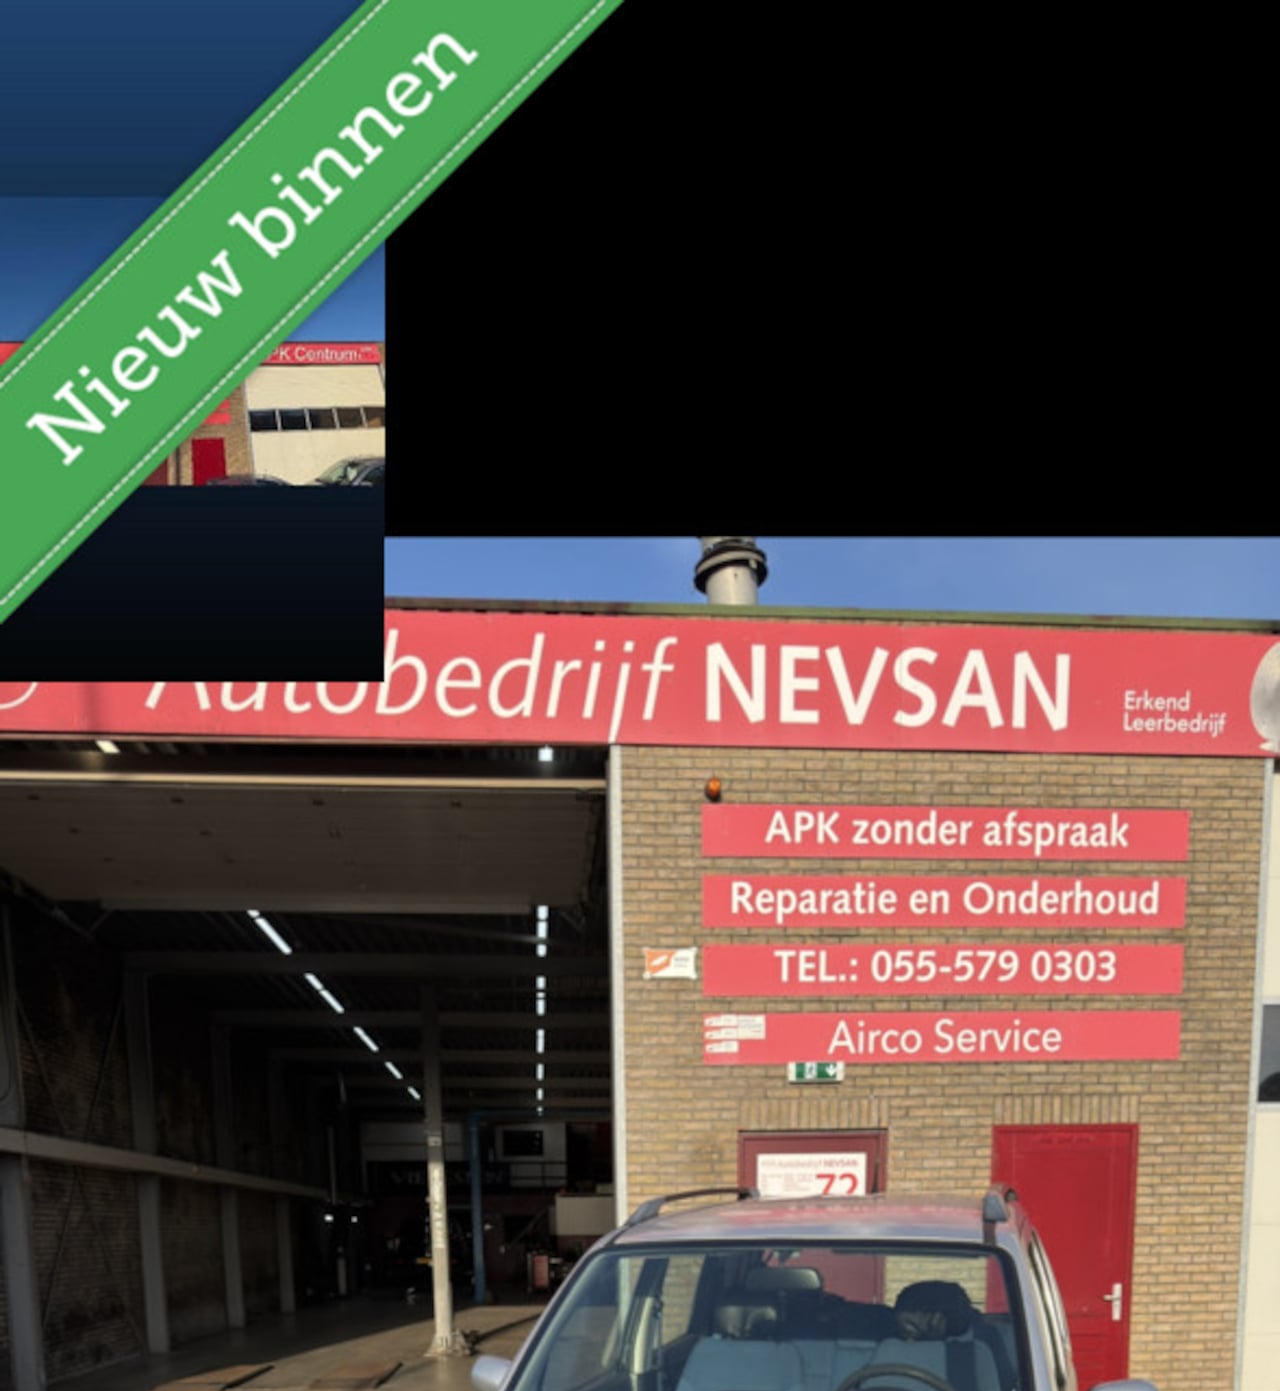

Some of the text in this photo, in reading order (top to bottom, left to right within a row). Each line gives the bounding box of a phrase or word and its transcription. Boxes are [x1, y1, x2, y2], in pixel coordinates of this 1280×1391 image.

[707, 643, 1070, 731] NEVSAN
[1124, 690, 1190, 711] Erkend
[1123, 712, 1226, 736] Leerbedrijf
[765, 810, 1129, 857] APK zonder afspraak
[731, 881, 1160, 924] Reparatie en Onderhoud
[774, 950, 1116, 982] TEL.: 055-579 0303
[828, 1018, 1062, 1054] Airco Service
